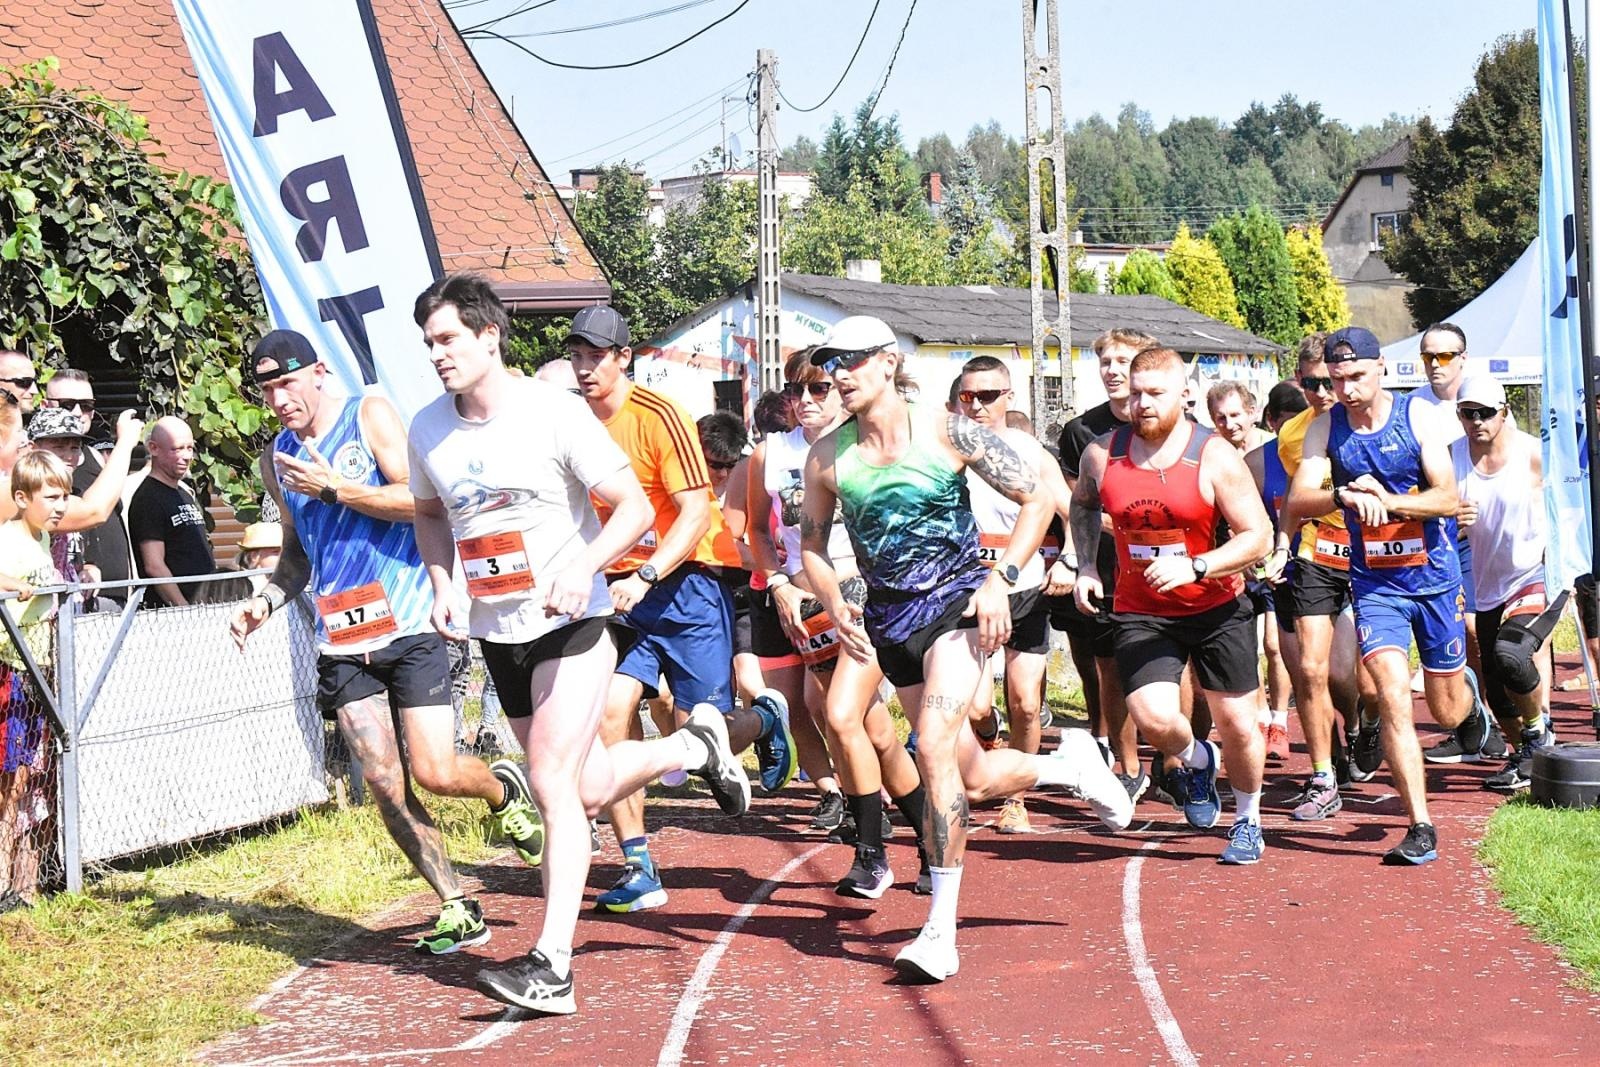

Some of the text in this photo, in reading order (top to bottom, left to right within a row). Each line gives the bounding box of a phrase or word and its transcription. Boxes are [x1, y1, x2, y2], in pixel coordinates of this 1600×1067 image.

[979, 548, 998, 561] 21
[1150, 546, 1160, 557] 7
[1332, 544, 1350, 557] 18
[1382, 541, 1404, 555] 10
[486, 557, 500, 576] 3
[344, 606, 365, 627] 17
[809, 632, 834, 649] 44
